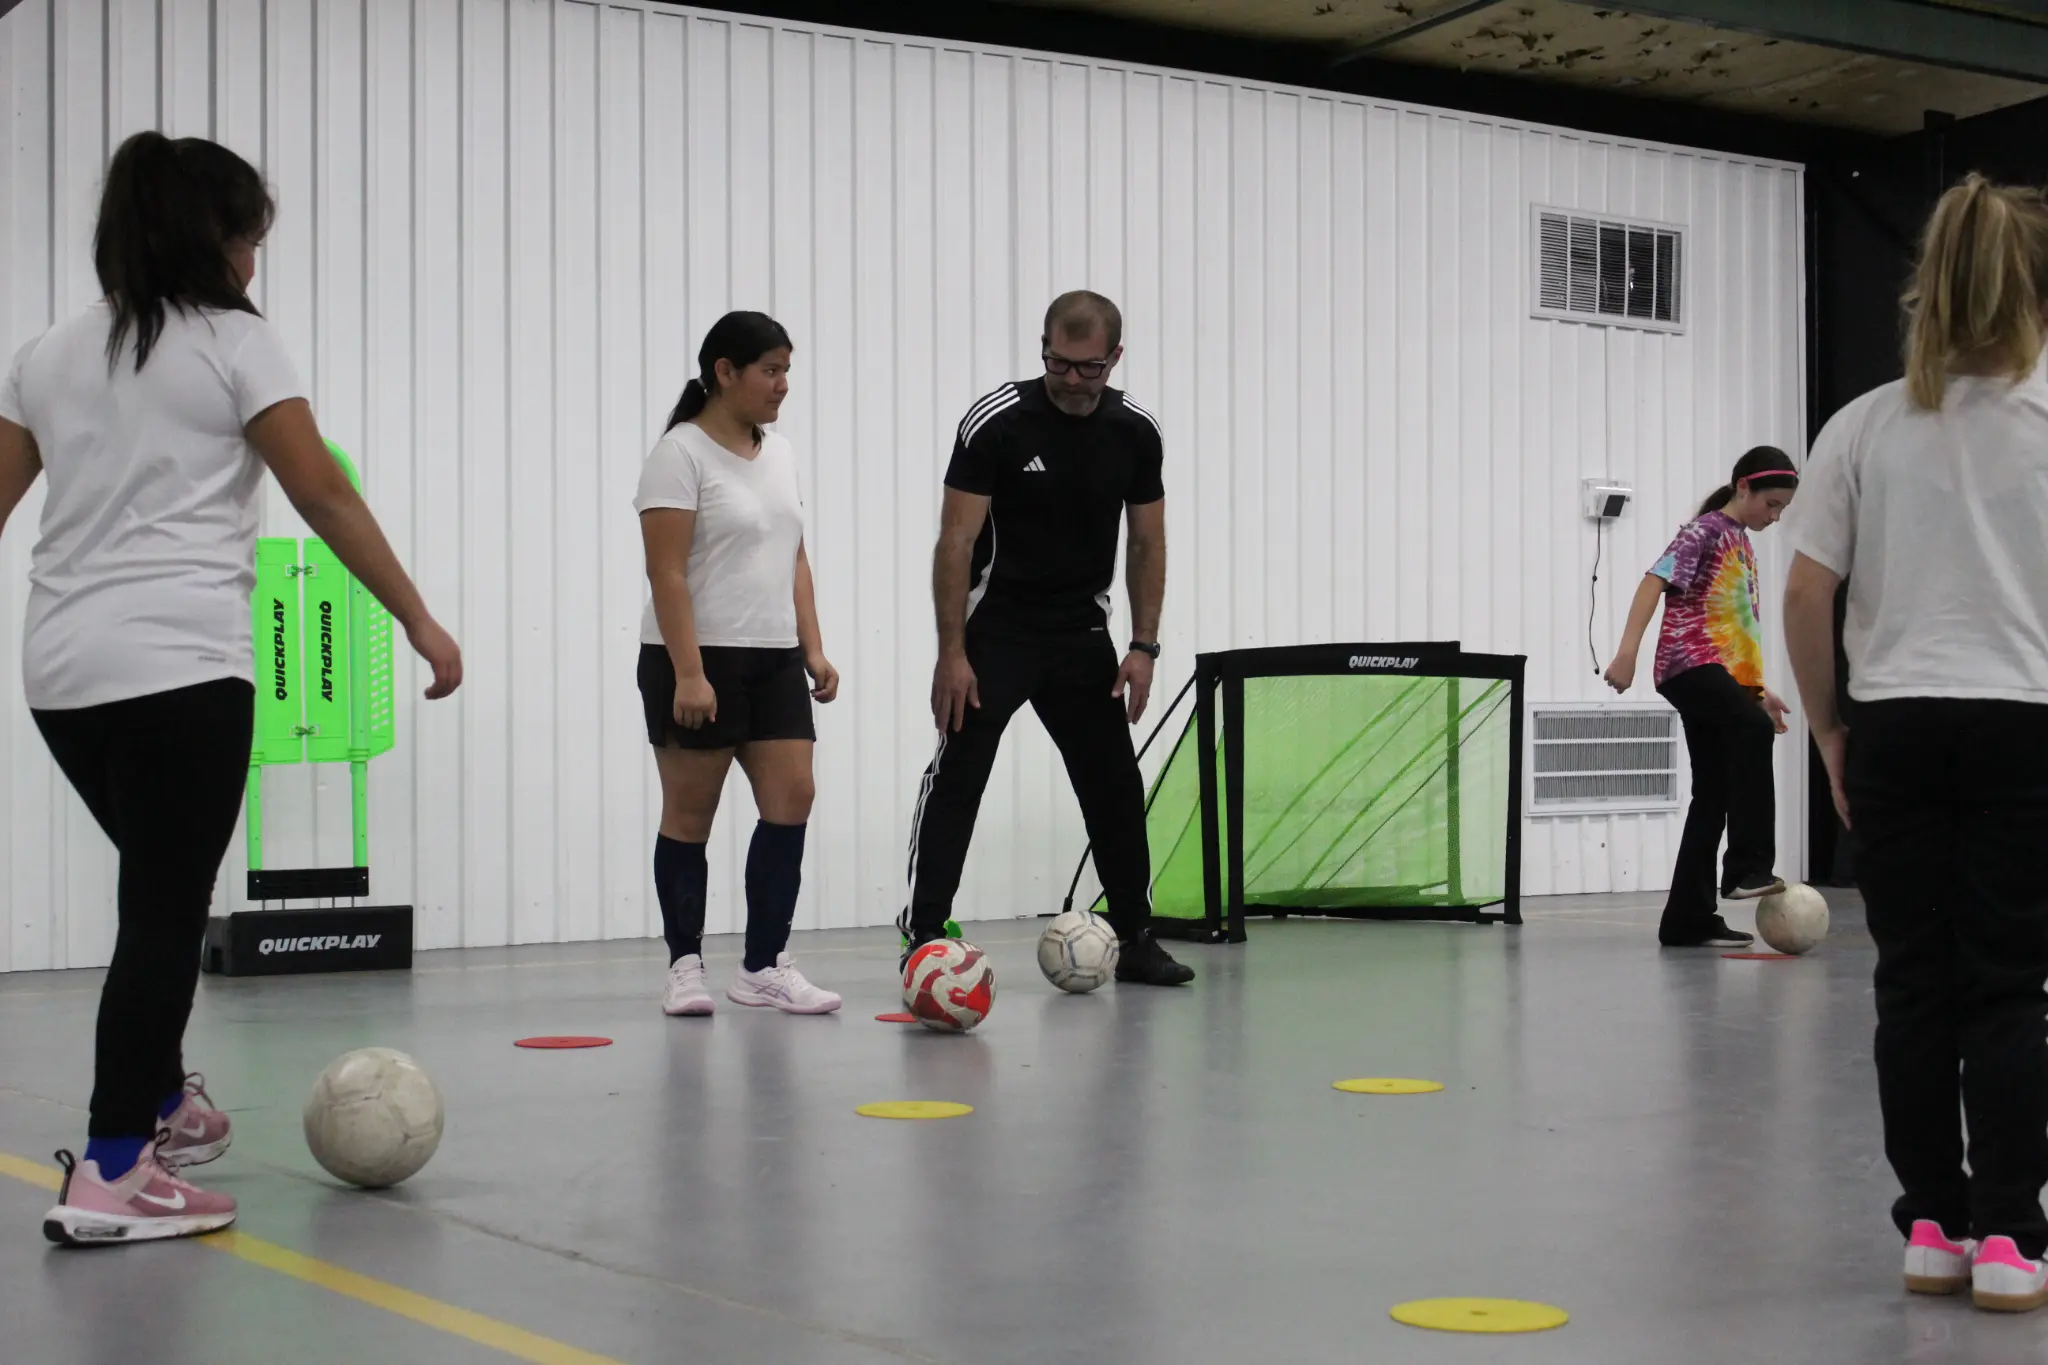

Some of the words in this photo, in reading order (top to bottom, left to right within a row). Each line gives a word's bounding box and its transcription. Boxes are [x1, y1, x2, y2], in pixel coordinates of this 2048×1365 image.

[273, 597, 288, 701] QUICKPLAY
[319, 600, 333, 703] QUICKPLAY
[1348, 655, 1420, 669] QUICKPLAY
[258, 934, 382, 956] QUICKPLAY
